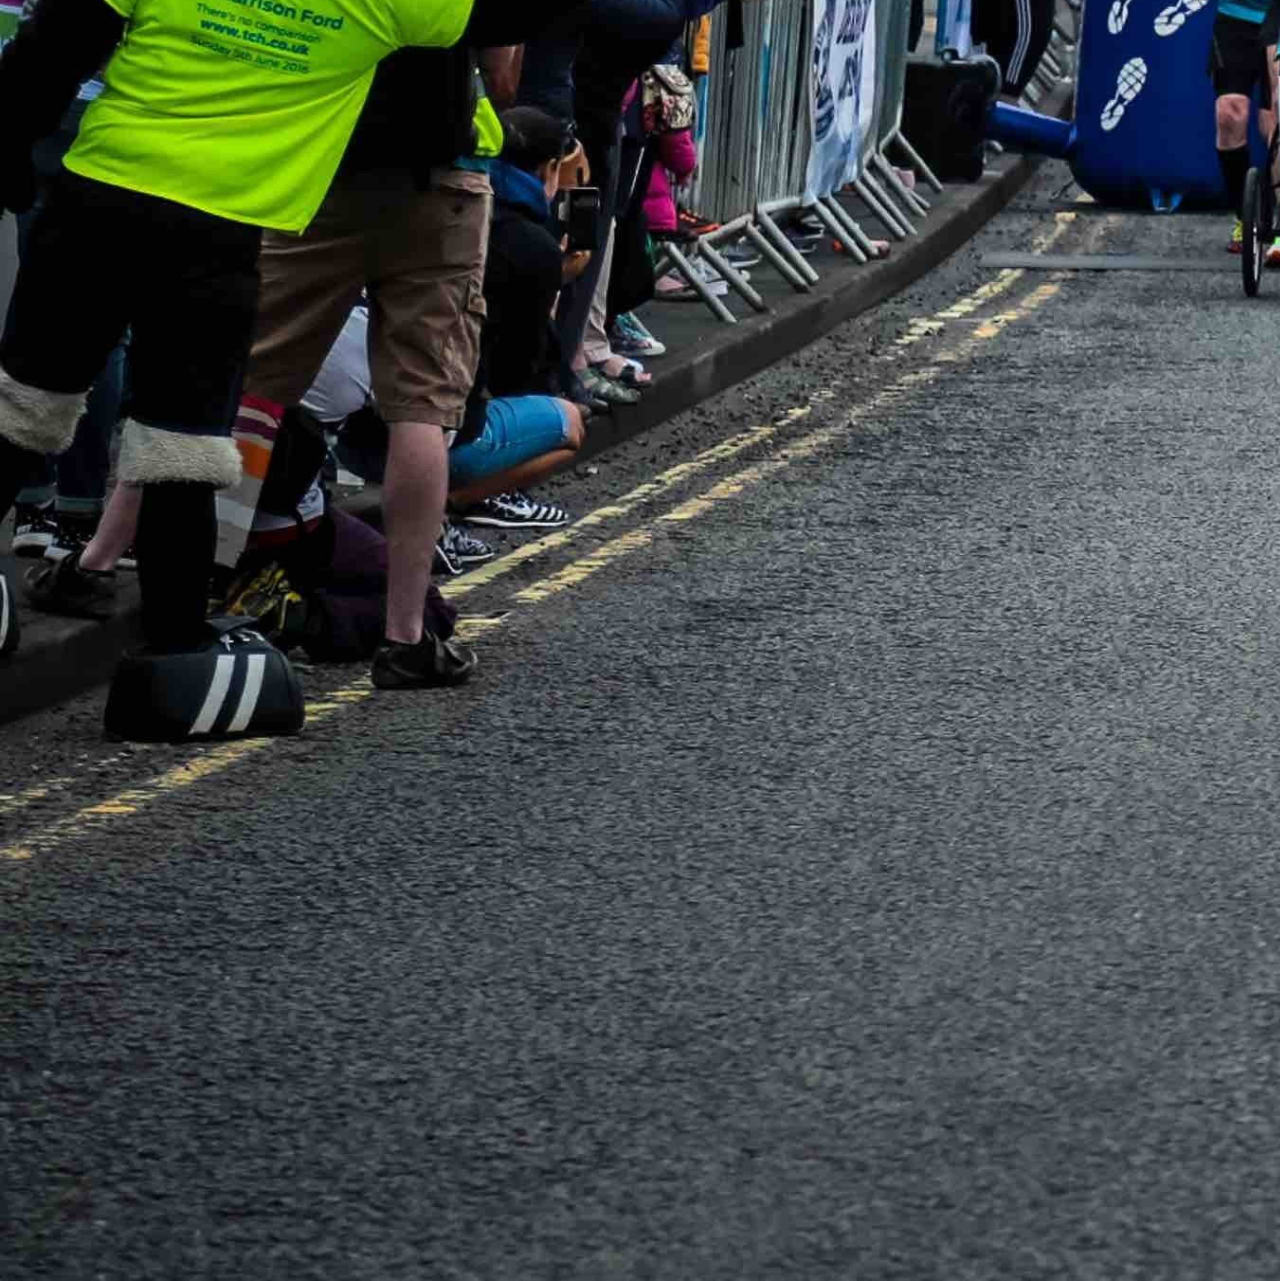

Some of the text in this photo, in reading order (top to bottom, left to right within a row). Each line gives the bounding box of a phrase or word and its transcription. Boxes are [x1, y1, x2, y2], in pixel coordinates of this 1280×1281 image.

[197, 2, 236, 22] There's
[238, 15, 253, 26] no
[300, 9, 344, 31] Ford
[200, 19, 310, 56] www.tch.co.uk
